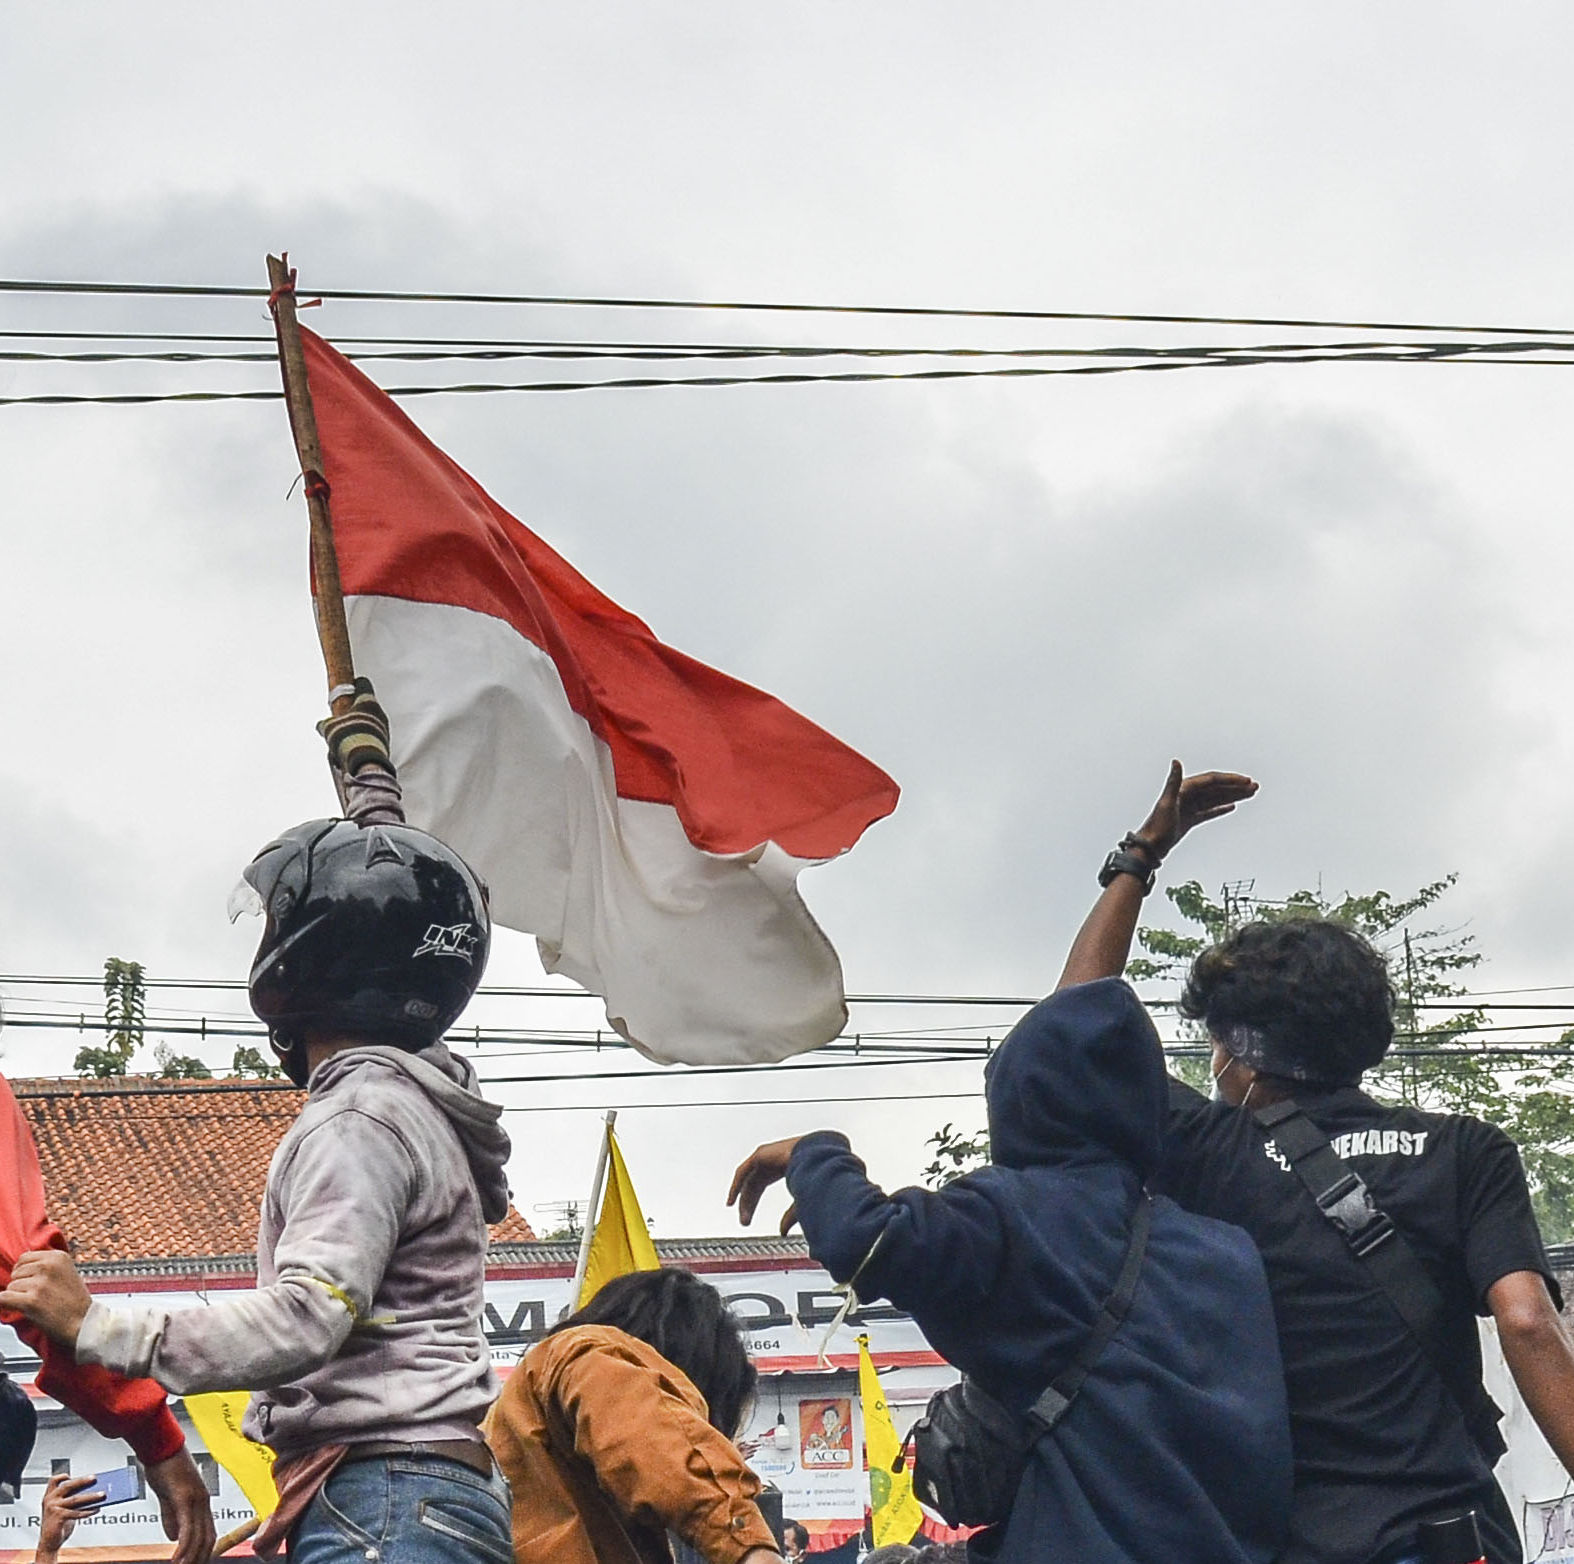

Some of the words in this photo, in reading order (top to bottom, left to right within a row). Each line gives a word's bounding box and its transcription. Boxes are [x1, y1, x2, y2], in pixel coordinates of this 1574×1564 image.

[413, 924, 478, 966] INK
[812, 1451, 844, 1462] ACC
[0, 1516, 21, 1528] Jl.
[76, 1511, 162, 1526] artadina
